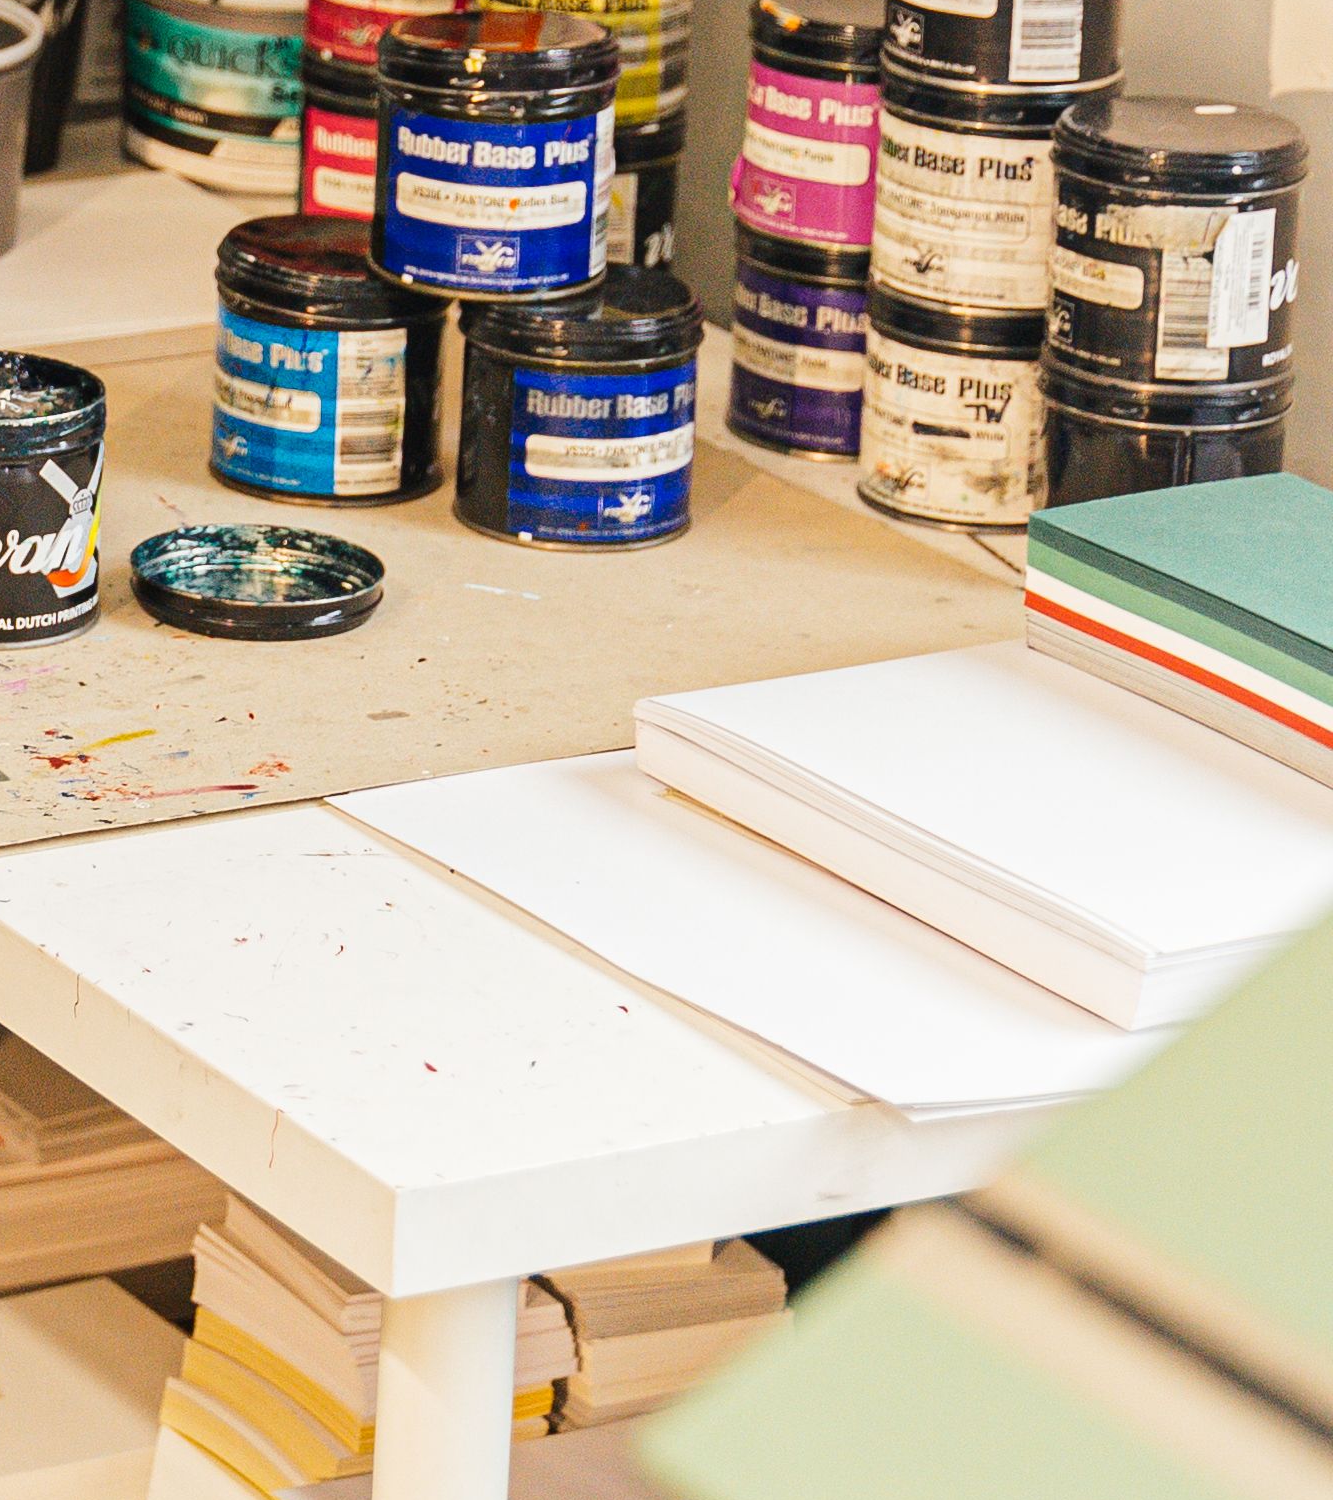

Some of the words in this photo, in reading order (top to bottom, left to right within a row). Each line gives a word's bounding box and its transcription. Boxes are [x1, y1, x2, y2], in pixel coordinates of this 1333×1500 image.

[818, 98, 874, 128] Plus
[397, 125, 471, 167] Rubber
[473, 140, 537, 170] Base
[914, 145, 966, 176] Base
[896, 363, 947, 395] Base
[958, 375, 1014, 402] Plus
[526, 388, 613, 421] Rubber
[616, 392, 669, 421] Base
[15, 611, 57, 631] DUTCH
